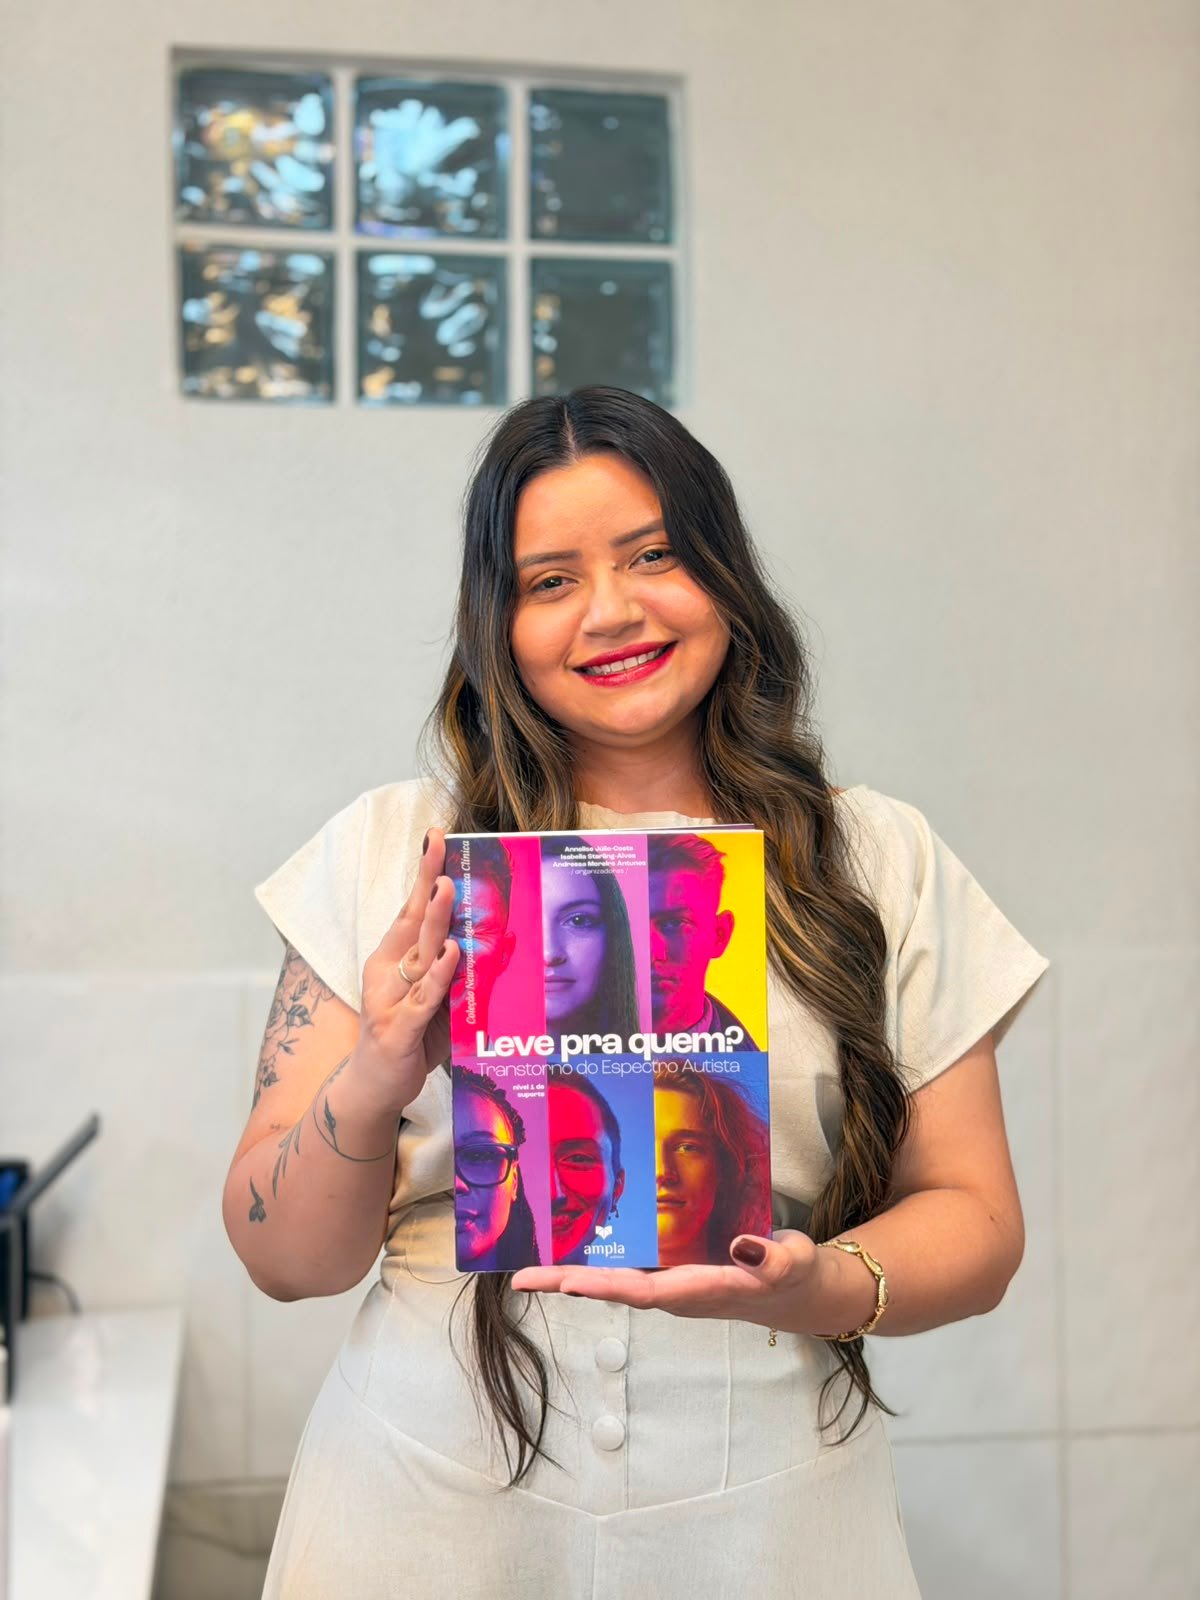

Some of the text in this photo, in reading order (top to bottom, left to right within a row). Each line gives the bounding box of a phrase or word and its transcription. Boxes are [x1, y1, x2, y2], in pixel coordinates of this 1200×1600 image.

[460, 840, 477, 1025] Coleção Neuropsicologia na Prática Clínica
[475, 1025, 744, 1063] Leve pra quem?
[476, 1058, 741, 1078] Transtorno do Espectro Autista
[583, 1241, 625, 1257] ampla
